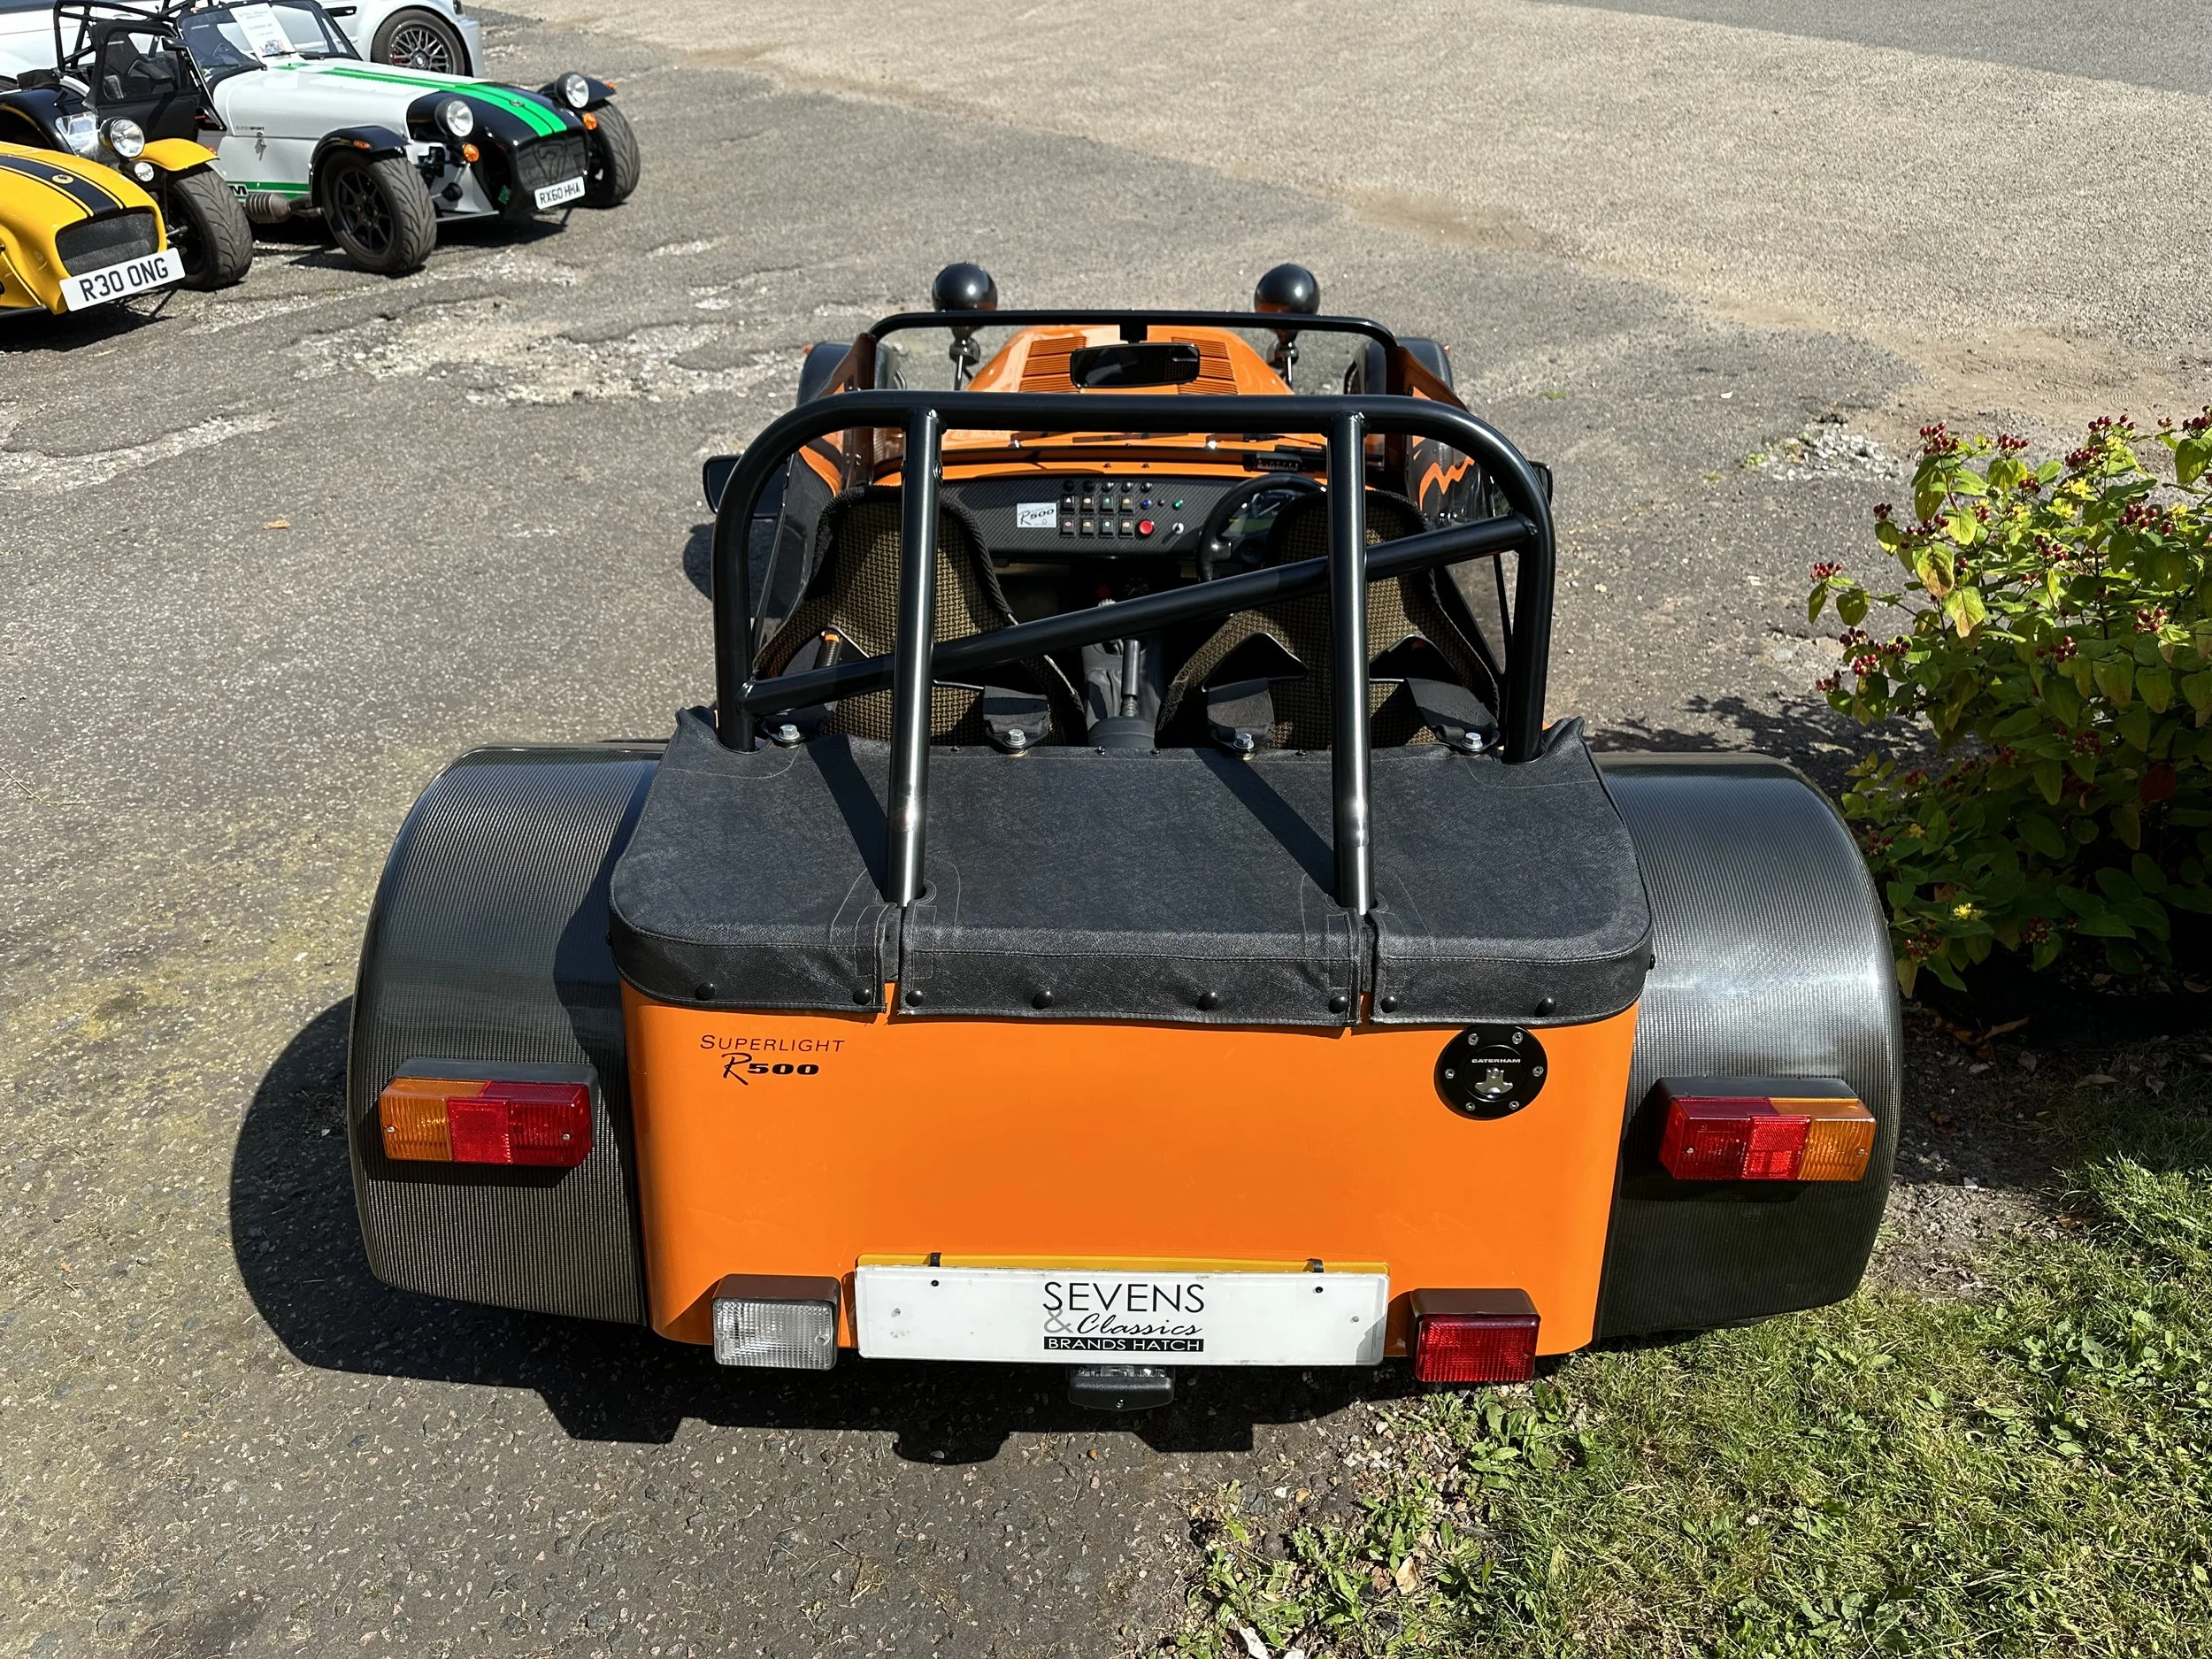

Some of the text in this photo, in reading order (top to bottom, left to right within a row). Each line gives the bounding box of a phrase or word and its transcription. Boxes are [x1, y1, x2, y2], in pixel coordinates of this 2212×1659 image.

[539, 181, 580, 204] RX60 HHA
[79, 257, 169, 302] R30 ONG
[1018, 509, 1055, 526] R500
[700, 1034, 845, 1052] SUPERLIGHT
[721, 1052, 819, 1086] R500
[1042, 1281, 1204, 1313] SEVENS
[1043, 1305, 1202, 1335] & Classics
[1048, 1338, 1200, 1351] BRANDS HATCH
